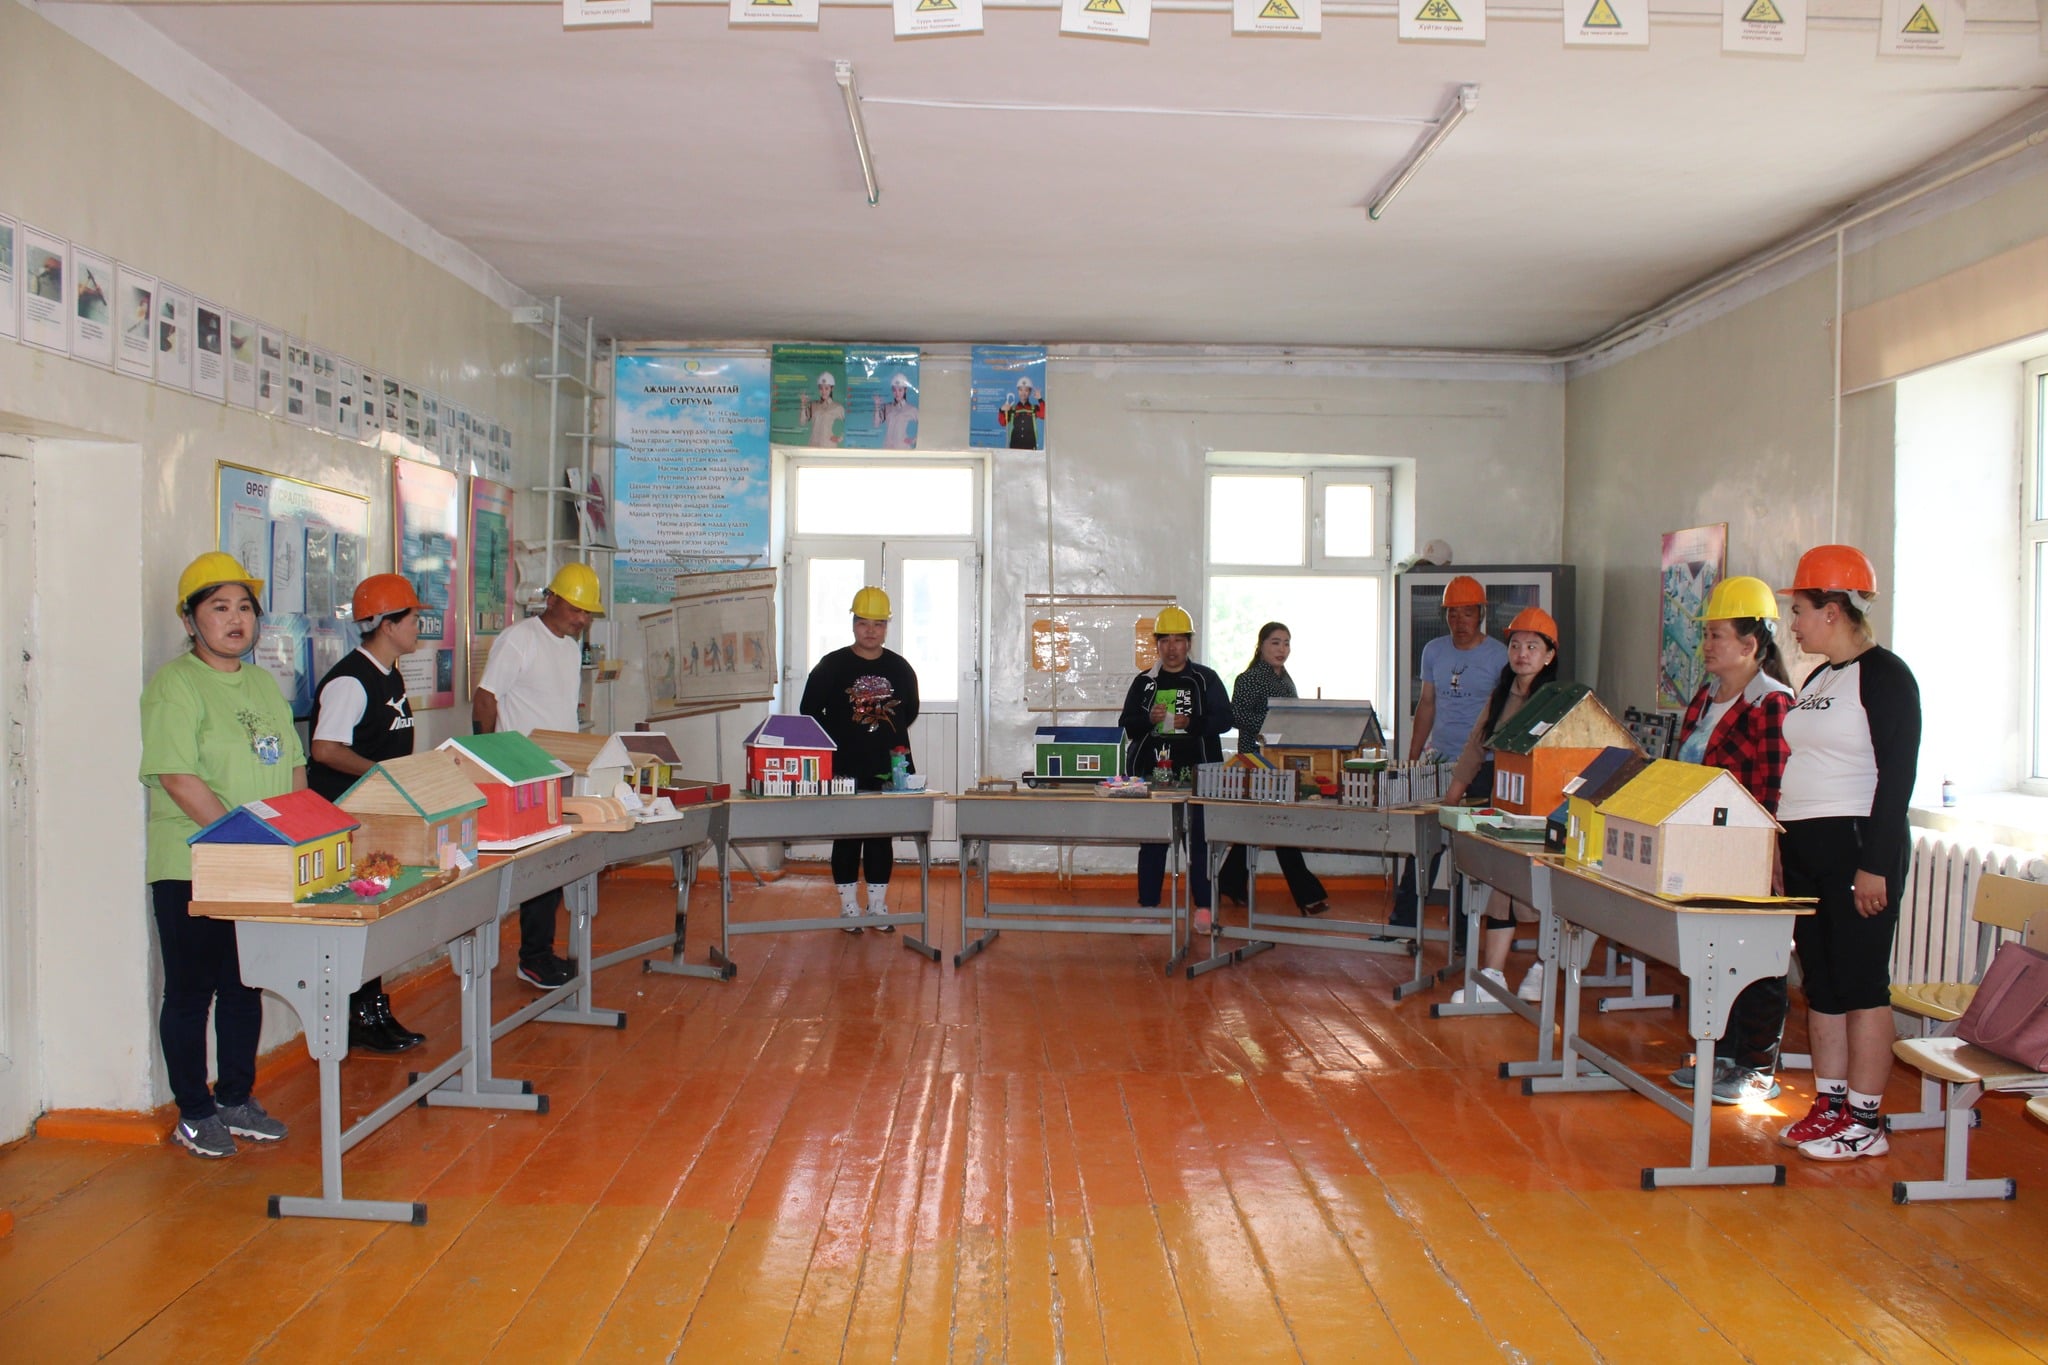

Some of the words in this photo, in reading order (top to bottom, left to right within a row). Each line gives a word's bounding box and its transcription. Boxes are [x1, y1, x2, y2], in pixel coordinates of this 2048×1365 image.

[643, 385, 676, 394] АЖЛЫН
[678, 384, 740, 394] ДУУДЛАГАТАЙ
[670, 397, 713, 406] СУРГУУЛЬ
